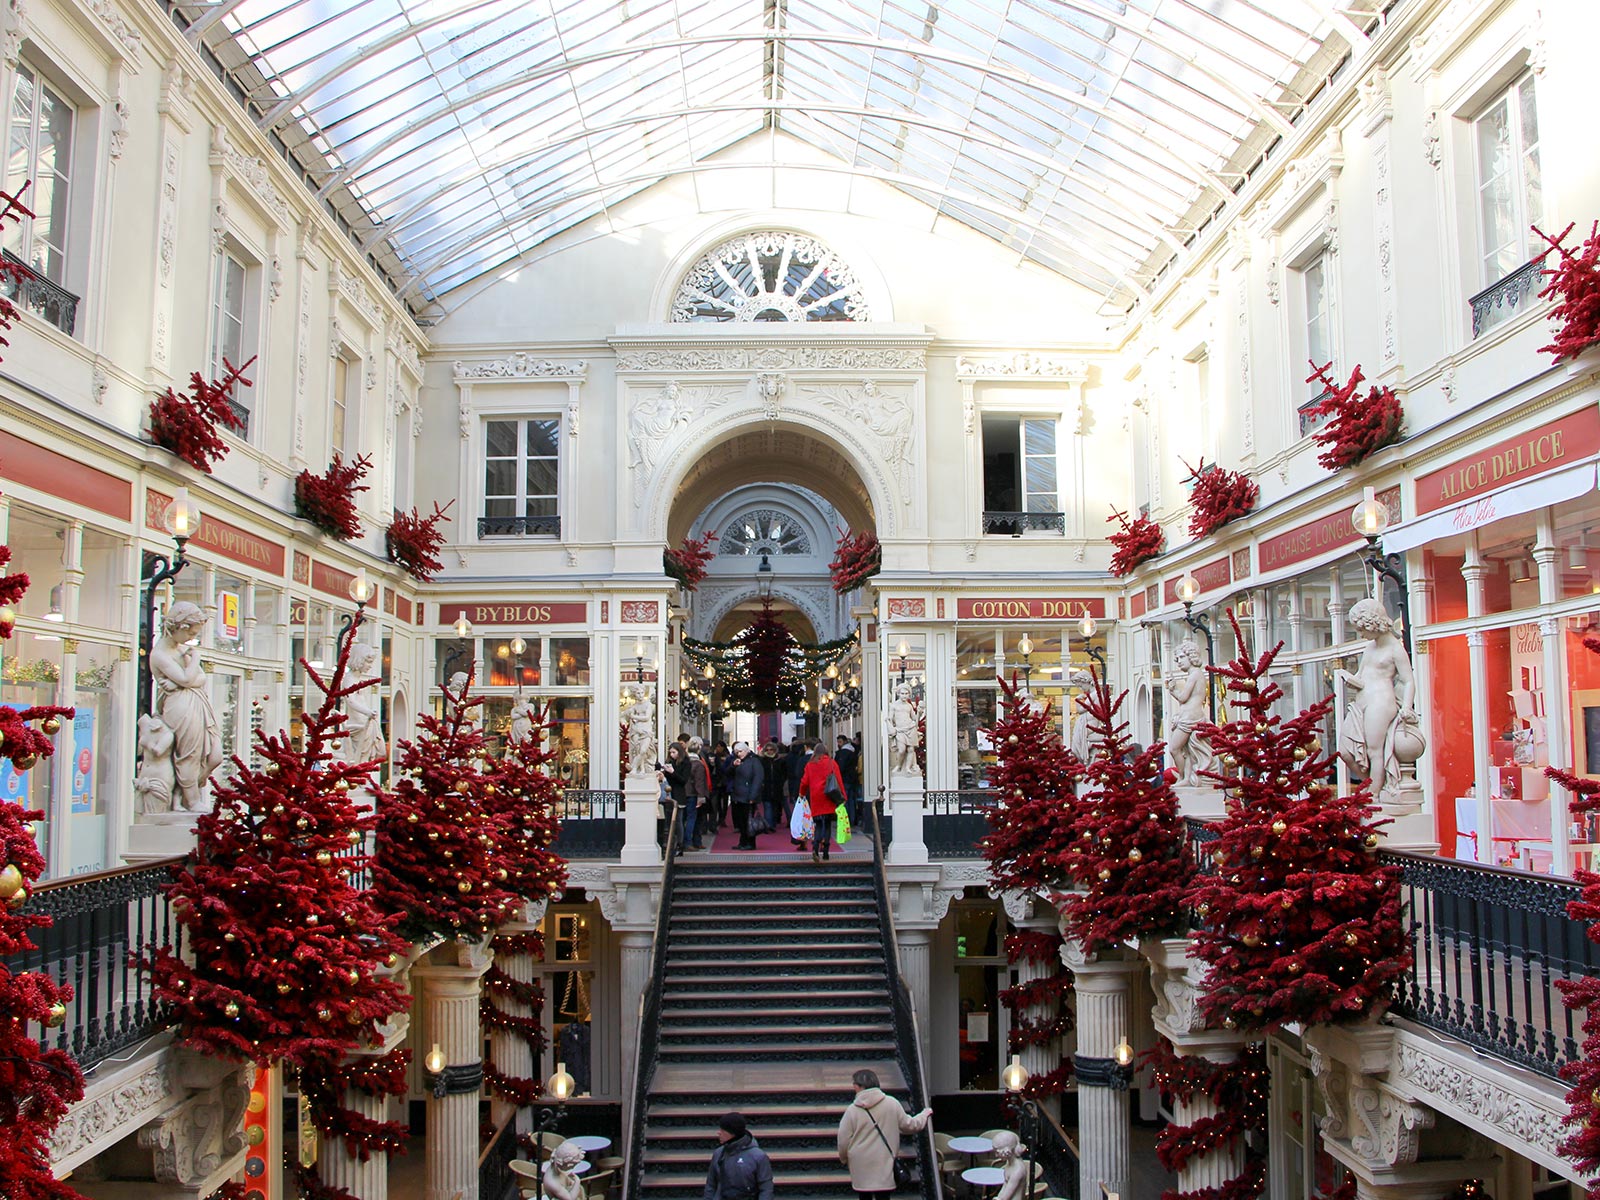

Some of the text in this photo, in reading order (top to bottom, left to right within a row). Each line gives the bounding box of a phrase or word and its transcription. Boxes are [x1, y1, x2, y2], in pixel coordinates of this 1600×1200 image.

[1440, 430, 1565, 501] ALICE DELICE
[197, 522, 271, 565] LES OPTICIENS
[1265, 544, 1276, 565] LA
[1280, 530, 1312, 560] CHAISE
[475, 605, 551, 622] BYBLOS
[972, 601, 1092, 617] COTON DOUX
